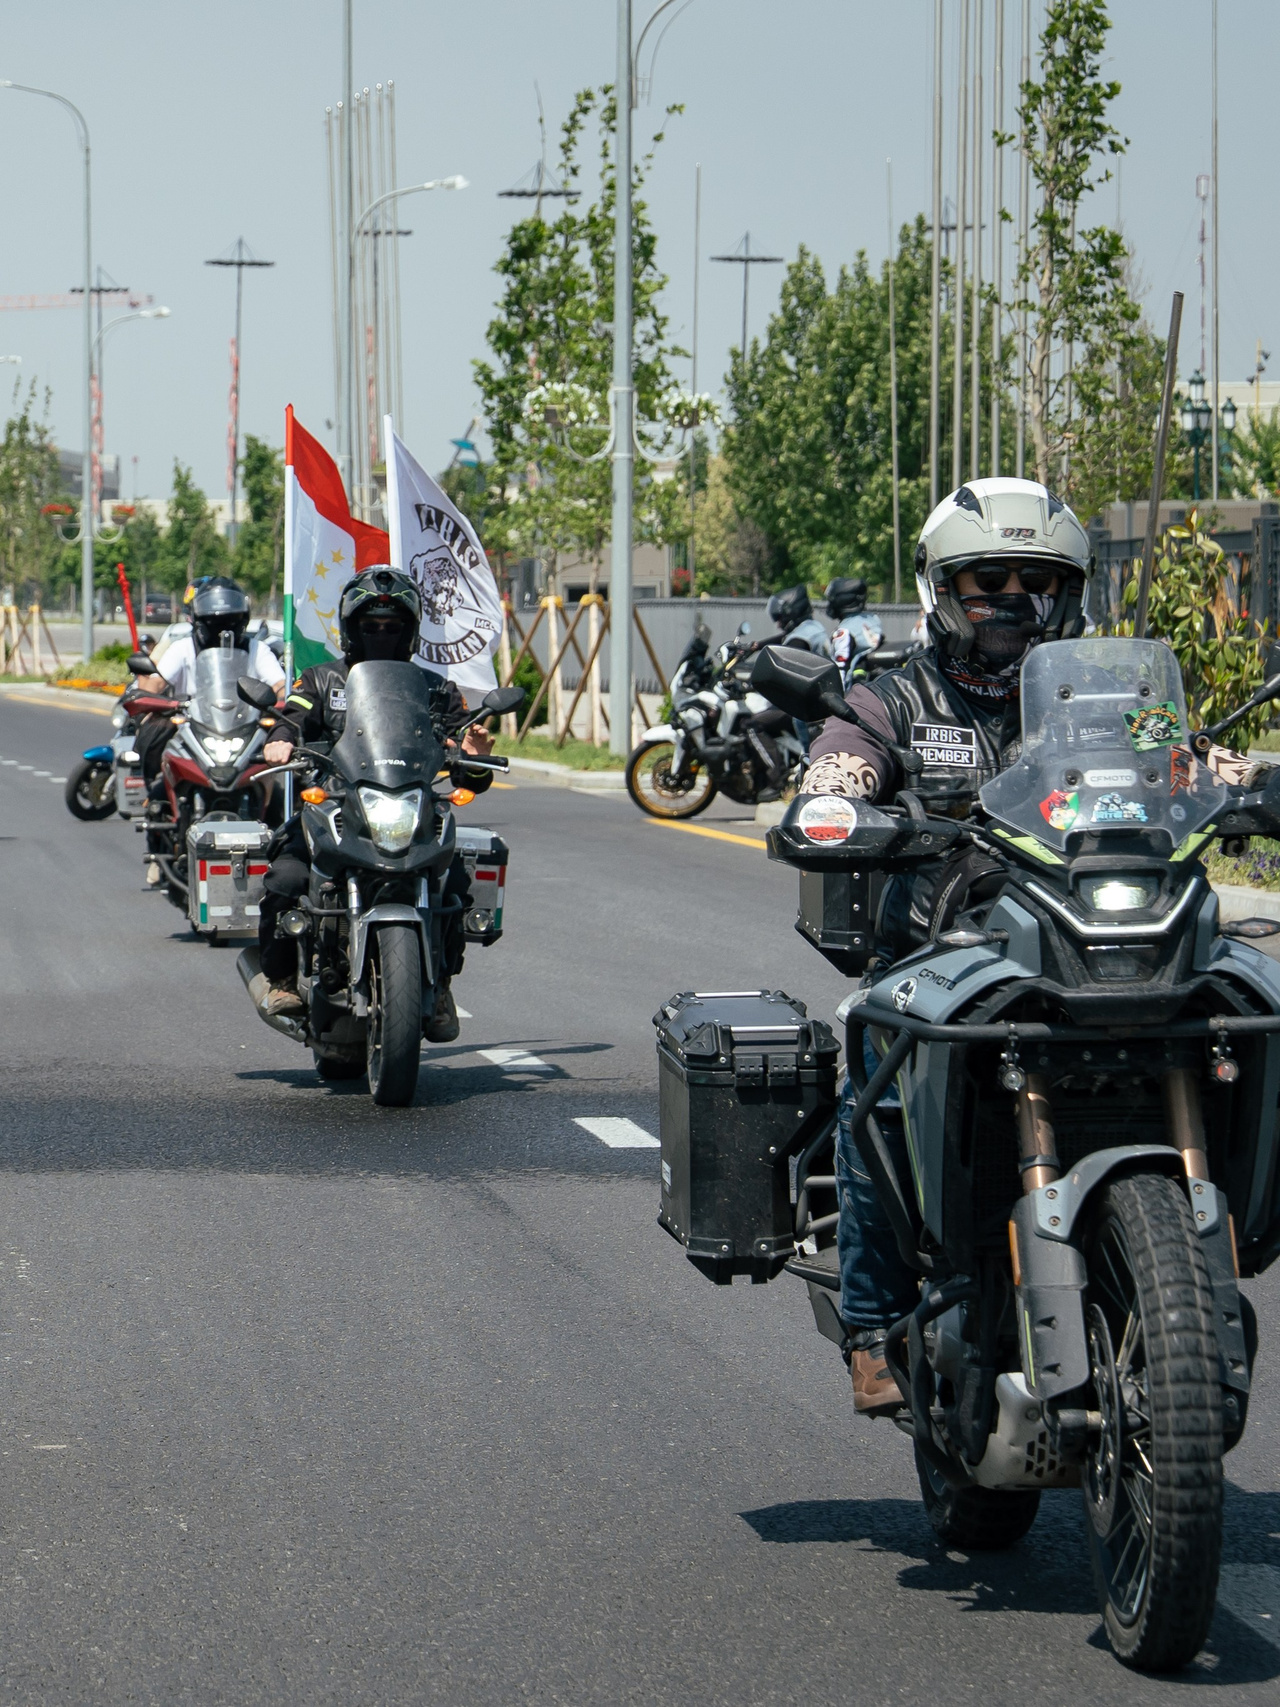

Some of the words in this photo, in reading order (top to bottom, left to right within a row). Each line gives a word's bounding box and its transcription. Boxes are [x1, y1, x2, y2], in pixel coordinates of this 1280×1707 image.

[420, 633, 483, 664] KISTAN
[925, 728, 962, 743] IRBIS
[916, 748, 971, 763] MEMBER
[918, 967, 958, 991] CFMOTO
